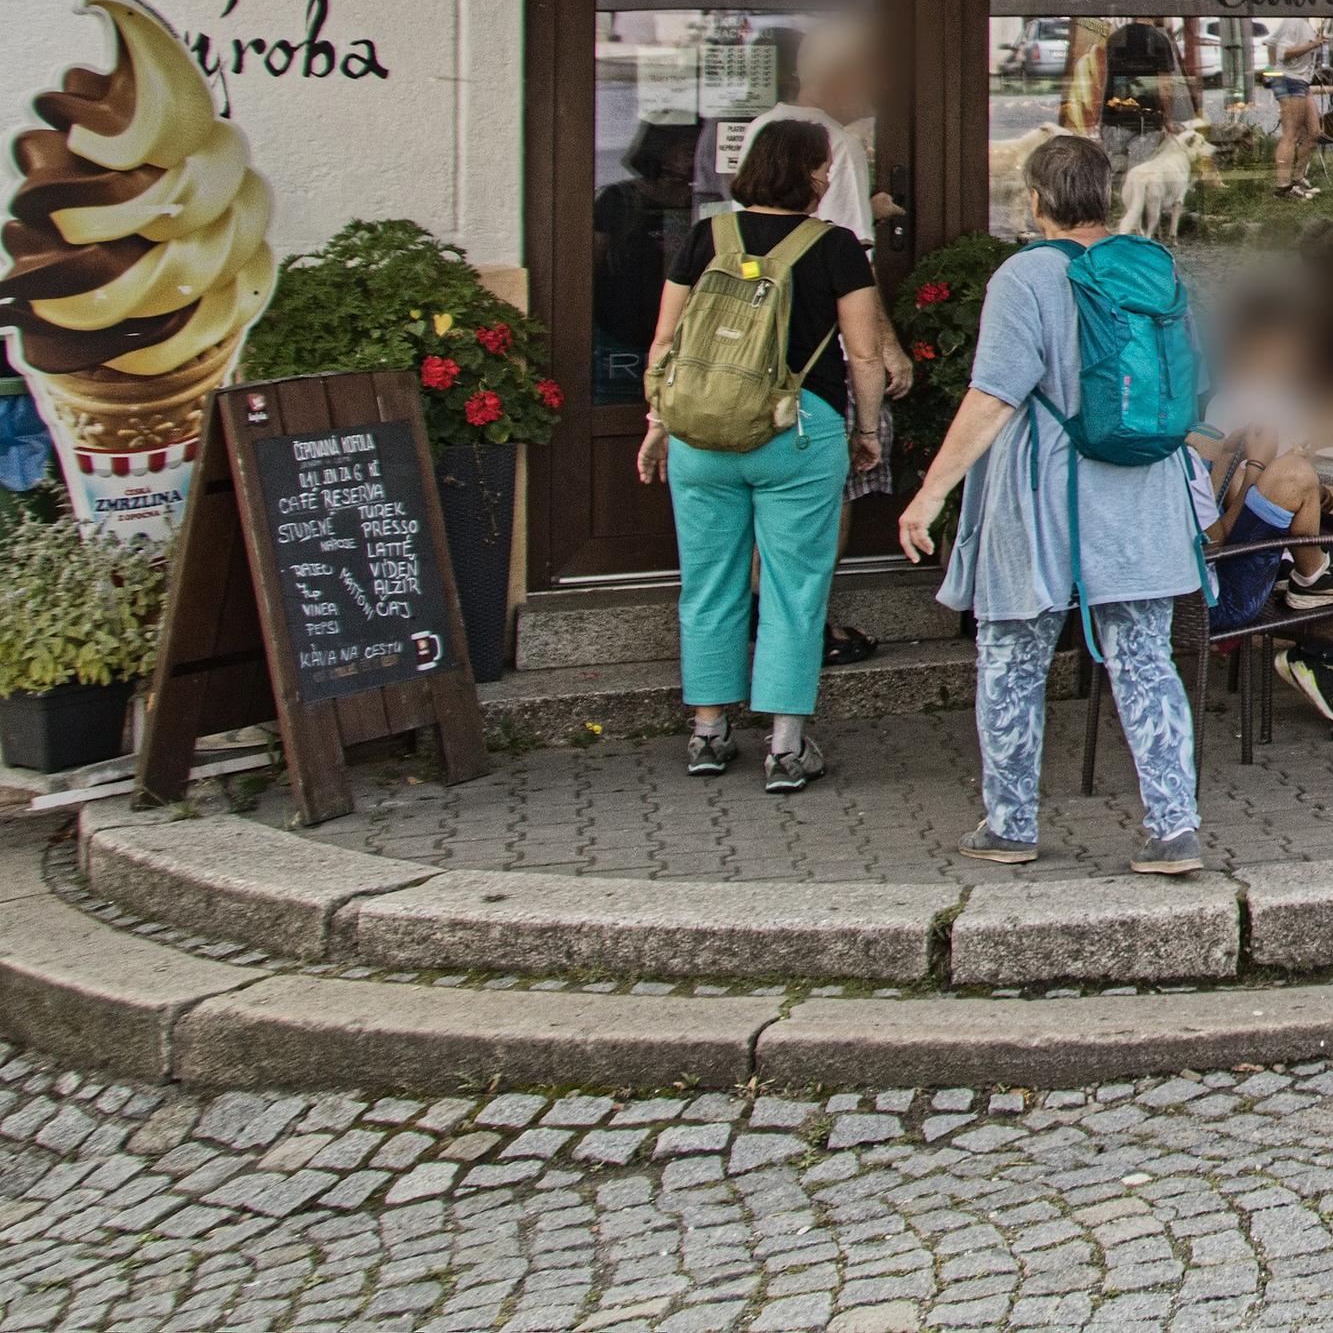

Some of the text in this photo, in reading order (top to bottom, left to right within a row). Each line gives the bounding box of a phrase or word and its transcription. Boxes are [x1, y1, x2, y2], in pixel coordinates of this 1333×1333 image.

[95, 490, 183, 512] ZMRZLINA
[278, 482, 386, 514] CAFÉ RESERVA
[357, 501, 405, 519] TUREK
[361, 519, 419, 538] PRESSO
[302, 603, 338, 616] VINEA
[375, 594, 411, 619] ČAJ
[340, 646, 358, 661] NA
[364, 640, 402, 659] CESTU
